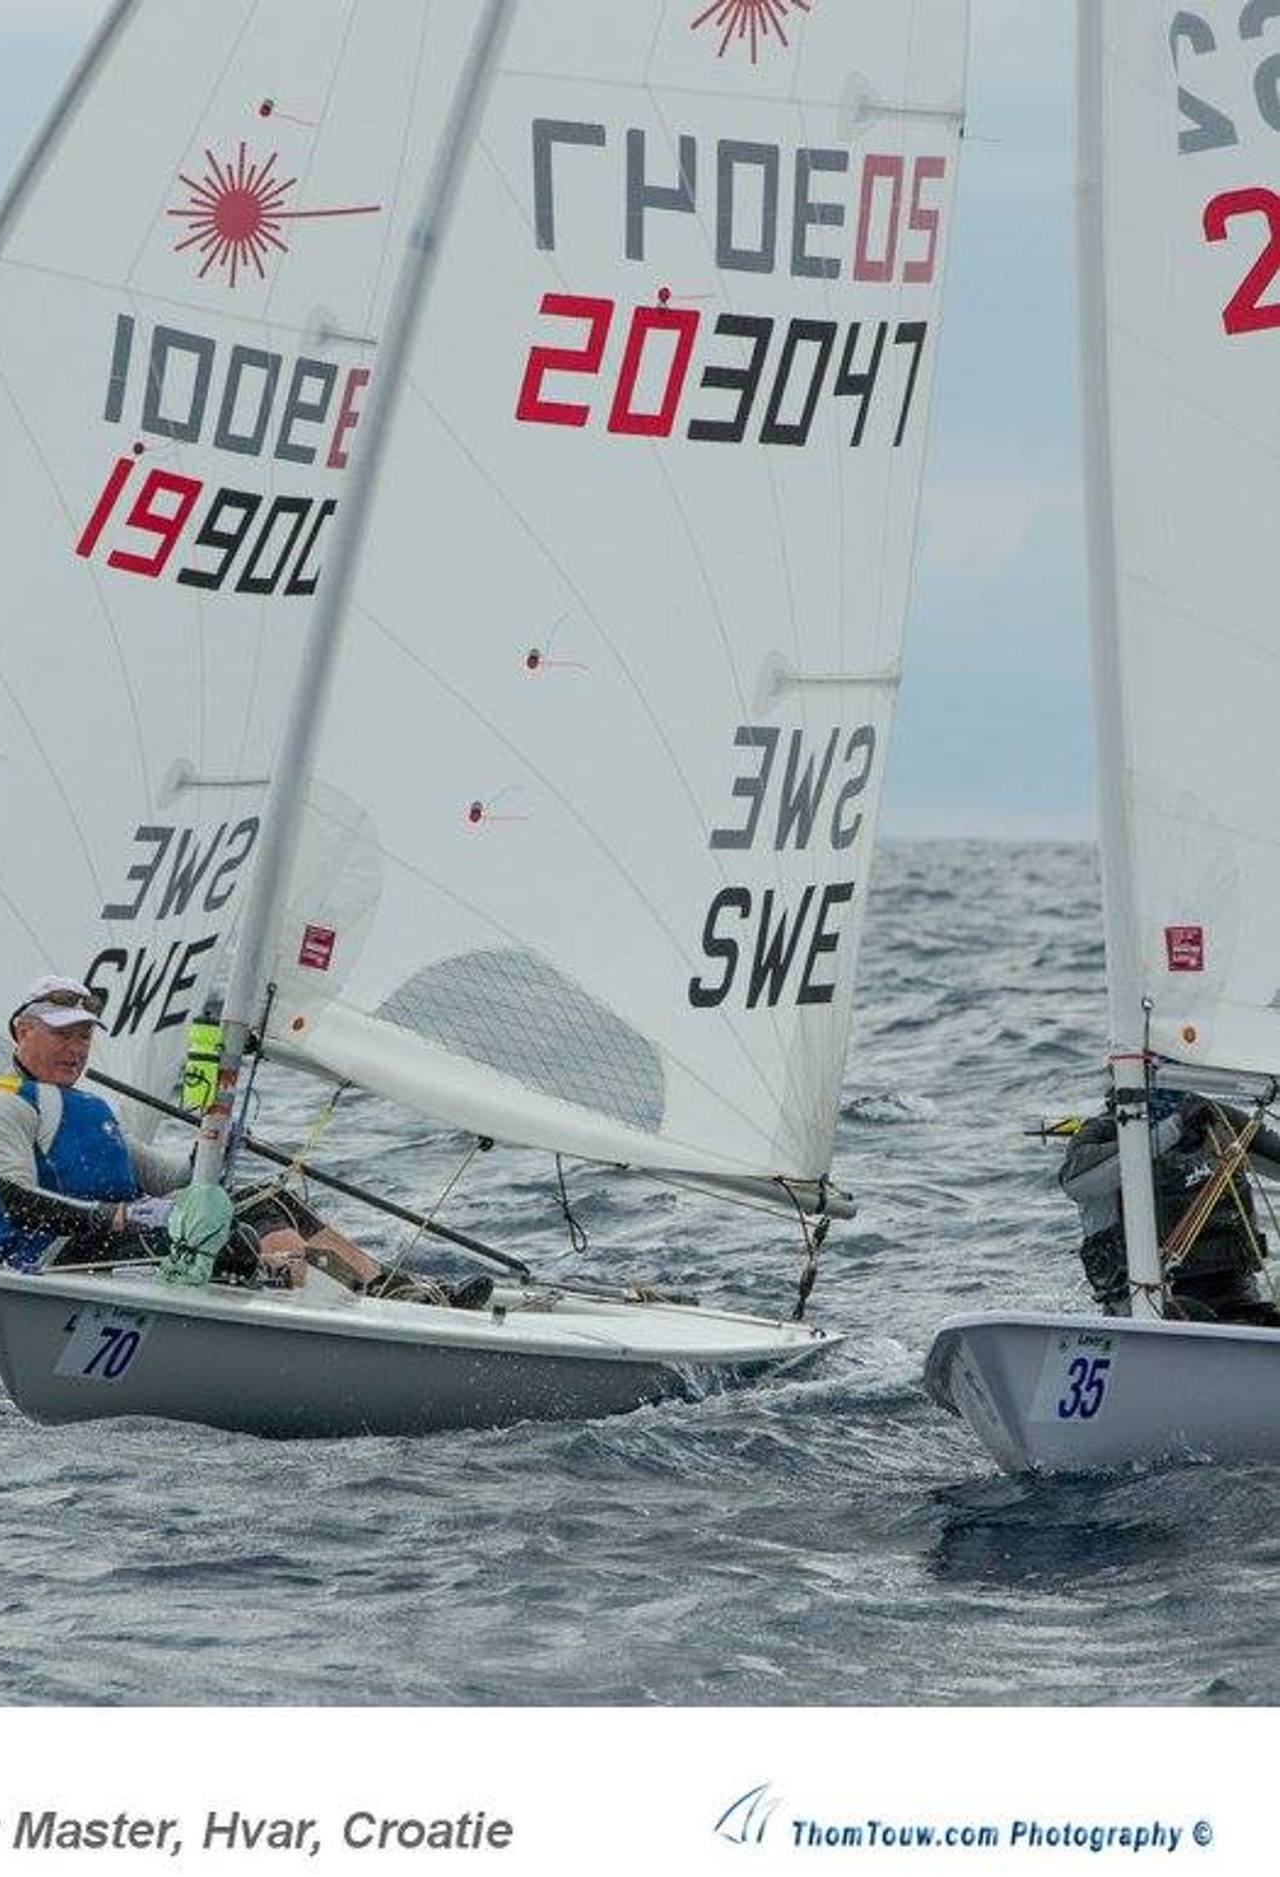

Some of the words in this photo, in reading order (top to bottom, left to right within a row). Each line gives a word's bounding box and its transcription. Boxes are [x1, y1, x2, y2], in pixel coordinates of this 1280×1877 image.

[516, 293, 927, 447] 203047
[82, 934, 219, 1038] SWE
[688, 882, 855, 1009] SWE
[82, 1326, 140, 1378] 70
[1058, 1358, 1111, 1419] 35
